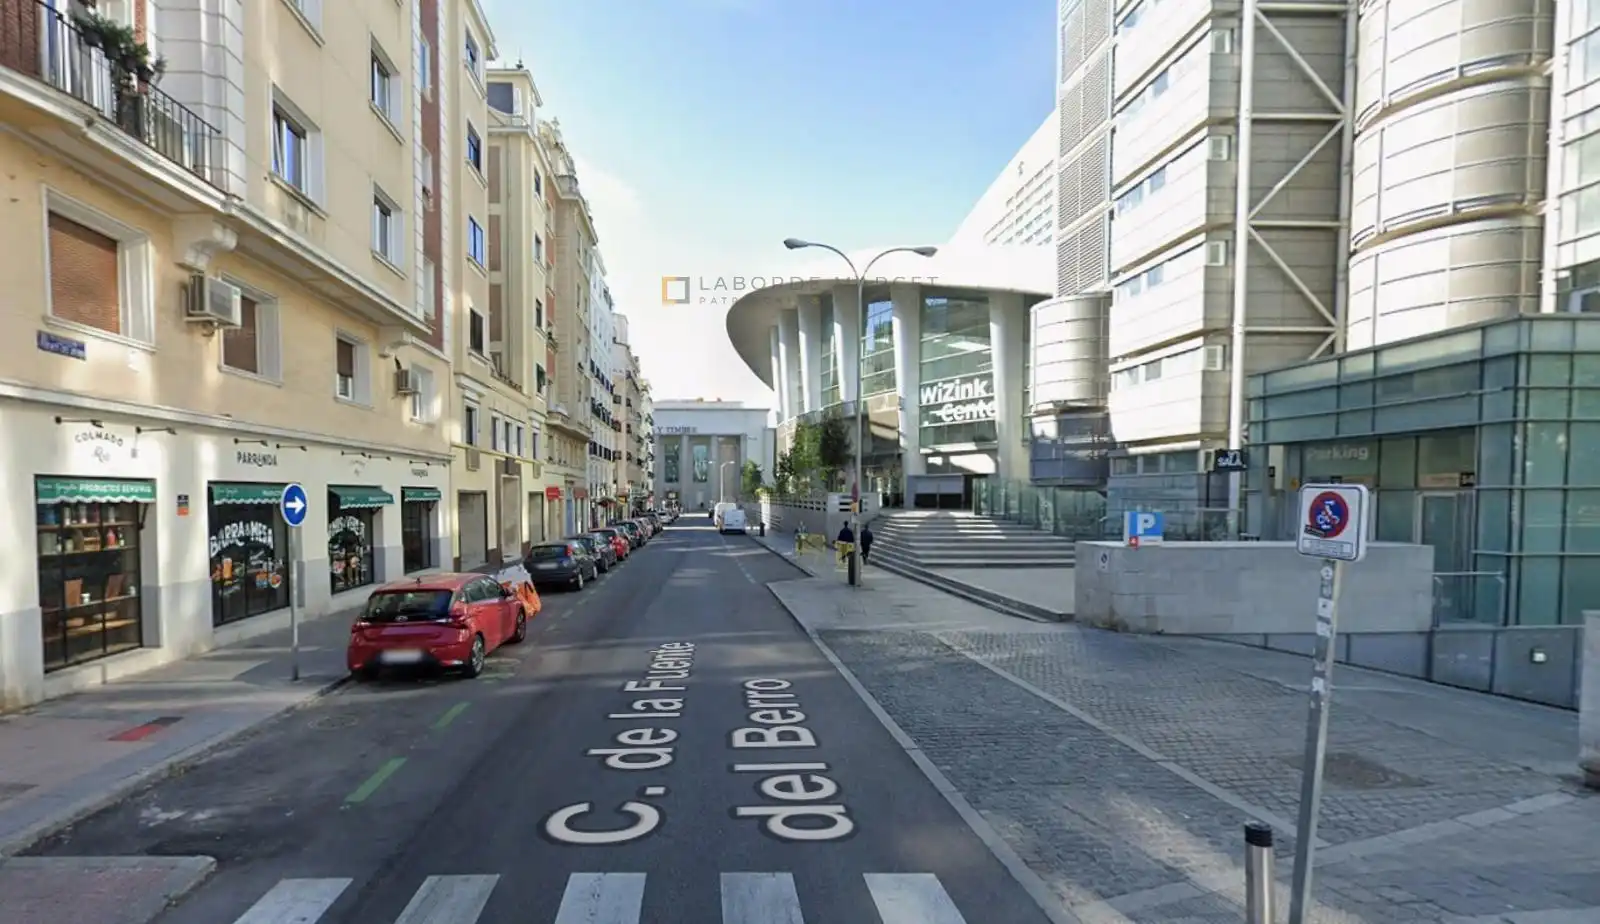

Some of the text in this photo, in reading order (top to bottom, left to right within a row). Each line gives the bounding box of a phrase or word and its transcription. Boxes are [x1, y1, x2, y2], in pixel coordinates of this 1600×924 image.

[929, 399, 997, 422] Cente
[74, 431, 124, 448] COLMADO
[1306, 445, 1369, 461] Parking
[1136, 513, 1156, 535] P
